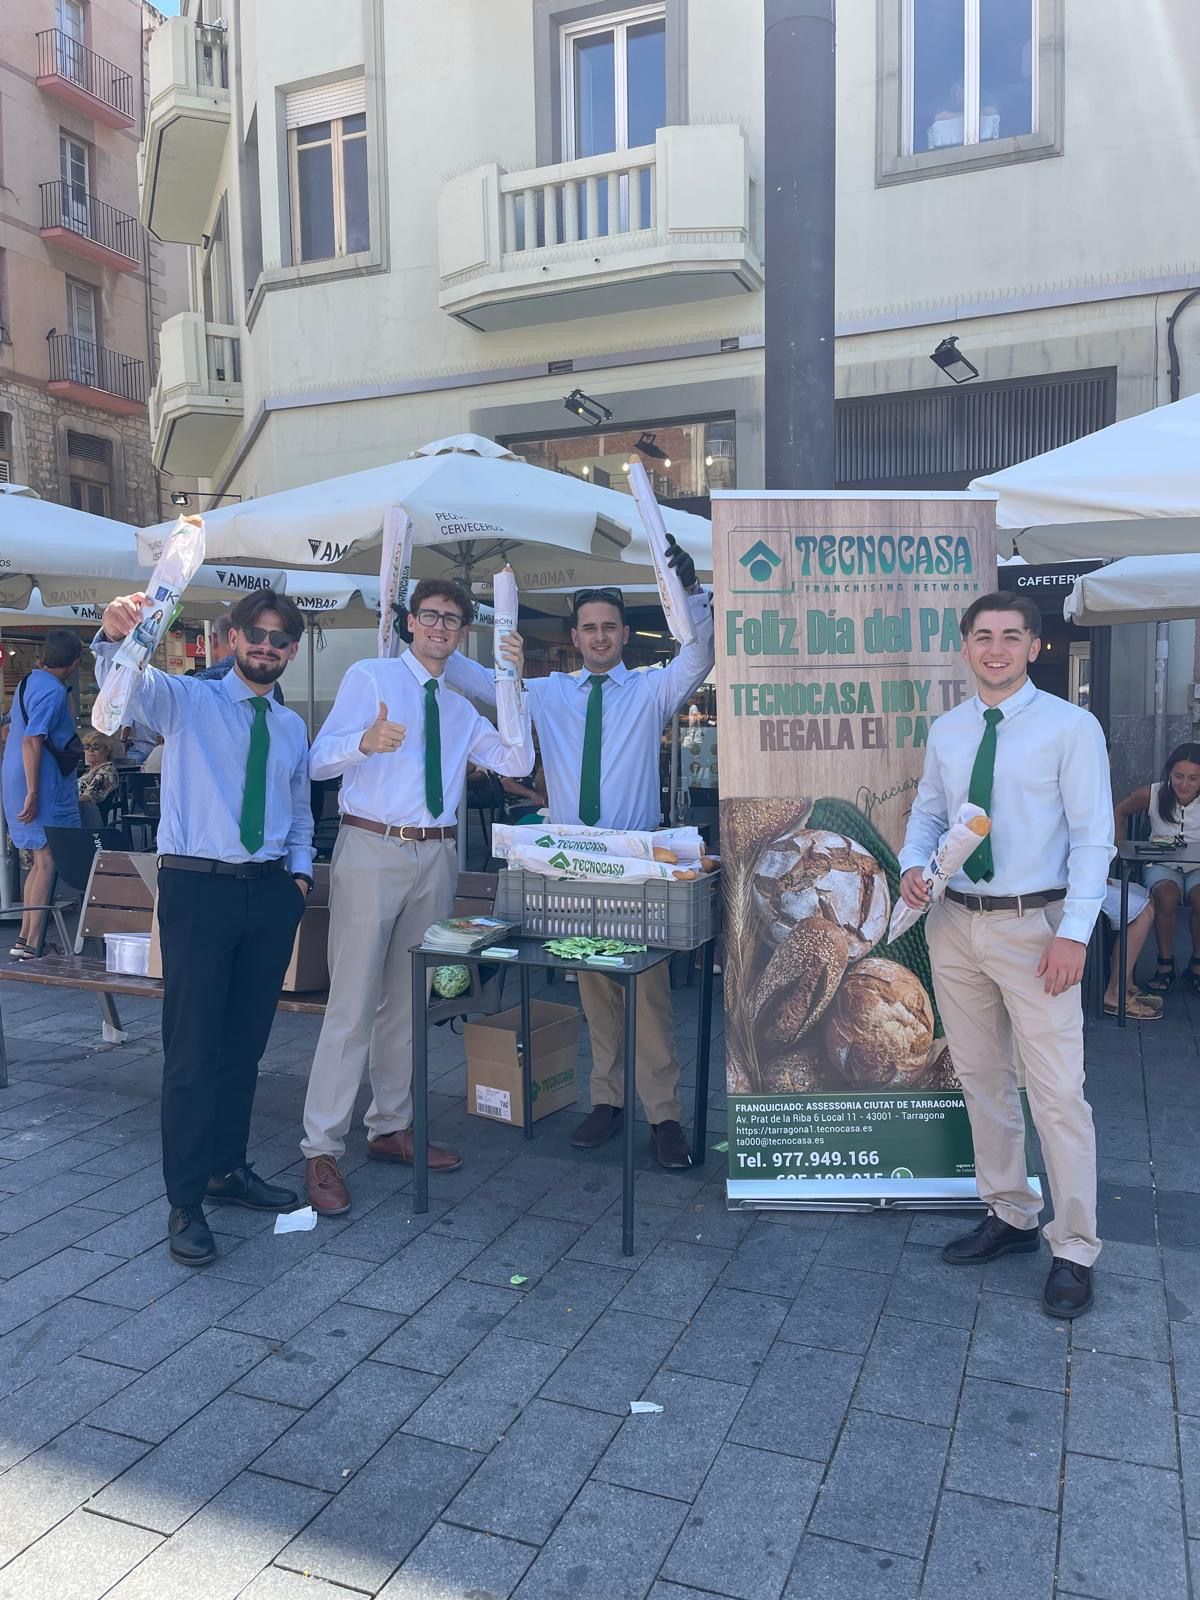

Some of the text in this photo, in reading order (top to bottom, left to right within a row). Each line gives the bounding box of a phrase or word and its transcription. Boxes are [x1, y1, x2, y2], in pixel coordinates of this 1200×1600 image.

[795, 535, 972, 576] TECNOCASA
[227, 573, 270, 589] AMBAR
[1017, 574, 1080, 587] CAFETER
[805, 583, 980, 593] FRANCHISING NETWORK
[296, 596, 338, 609] AMBAR
[725, 607, 969, 656] Feliz Día del PA
[730, 679, 967, 716] TECNOCASA HOY TE
[760, 715, 939, 751] REGALA EL PA
[557, 839, 608, 852] TECNOCASA
[572, 858, 624, 876] TECNOCASA
[735, 1100, 965, 1112] FRANQUICIADO: ASSESSORIA CIUTAT DE TARRAGONA
[736, 1115, 748, 1123] Av.
[751, 1114, 768, 1123] Prat
[770, 1114, 780, 1123] de
[783, 1114, 790, 1122] la
[793, 1113, 811, 1122] Riba
[814, 1113, 819, 1121] 6
[821, 1113, 844, 1122] Local
[847, 1112, 856, 1120] 11
[866, 1112, 892, 1120] 43001
[901, 1111, 945, 1122] Tarragona
[736, 1125, 873, 1136] https://tarragona1.tecnocasa.es
[737, 1137, 825, 1147] ta000@tecnocasa.es
[737, 1150, 880, 1168] Tel. 977.949.166
